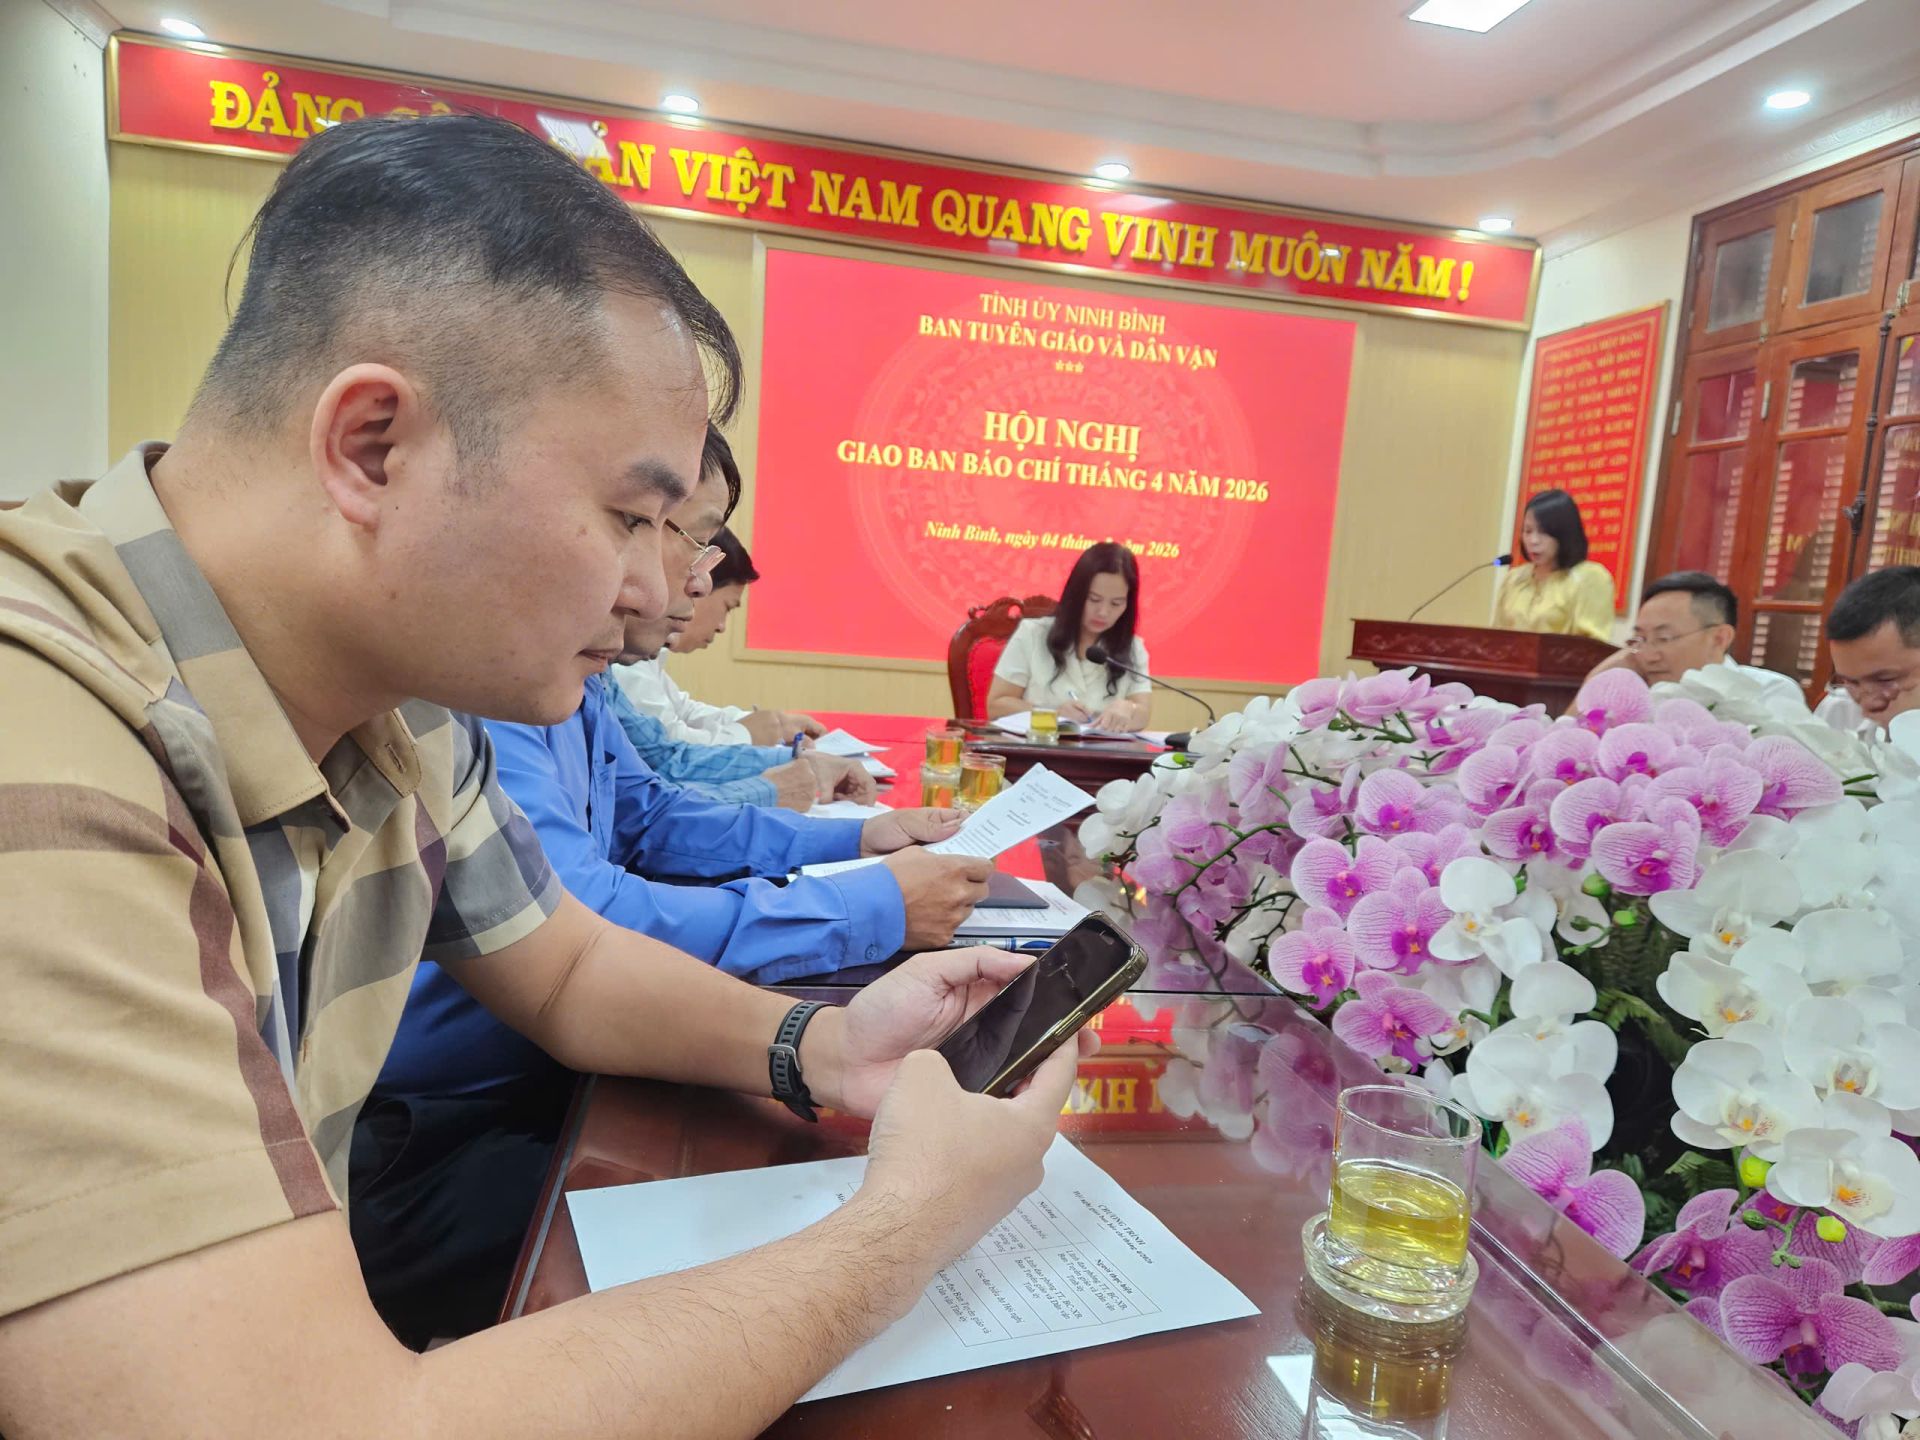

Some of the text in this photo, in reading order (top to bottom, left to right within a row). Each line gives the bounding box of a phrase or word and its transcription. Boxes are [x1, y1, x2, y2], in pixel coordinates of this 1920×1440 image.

[580, 120, 656, 189] ẢN
[669, 147, 795, 213] VIỆT
[808, 170, 922, 227] NAM
[932, 189, 1092, 252] QUANG
[1100, 212, 1218, 268] VINH
[1226, 230, 1352, 285] MUÔN
[980, 291, 1165, 334] TỈNH ỦY NINH BÌNH
[919, 315, 1218, 371] BAN TUYÊN GIÁO VÀ DÂN VẬN
[984, 410, 1141, 462] HỘI NGHỊ
[837, 440, 1269, 502] GIAO BAN BÁO CHÍ THÁNG 4 NĂM 2026
[924, 521, 961, 539] Ninh
[964, 524, 1002, 544] Bình,
[1004, 530, 1039, 549] ngày
[1041, 532, 1059, 548] 04
[1147, 541, 1180, 557] 2026
